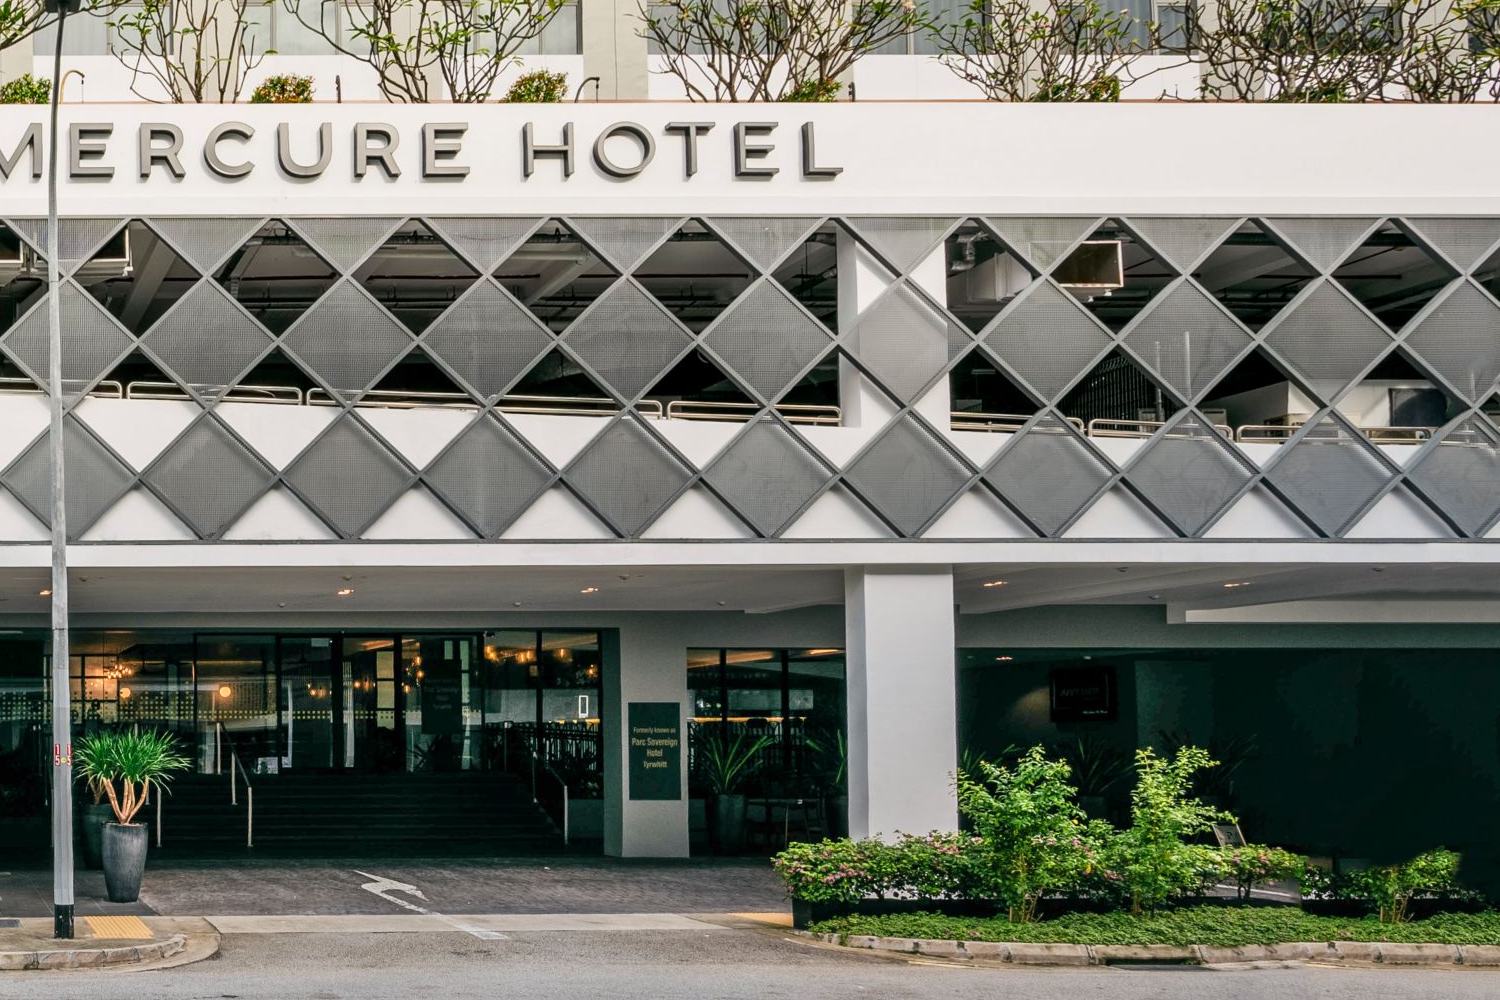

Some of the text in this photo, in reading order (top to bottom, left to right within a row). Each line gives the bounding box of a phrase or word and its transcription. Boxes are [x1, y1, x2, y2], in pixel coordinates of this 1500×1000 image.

[521, 121, 845, 182] HOTEL
[633, 726, 653, 735] Formerly
[631, 737, 678, 748] Parc Sovereign
[646, 748, 663, 757] Hotel
